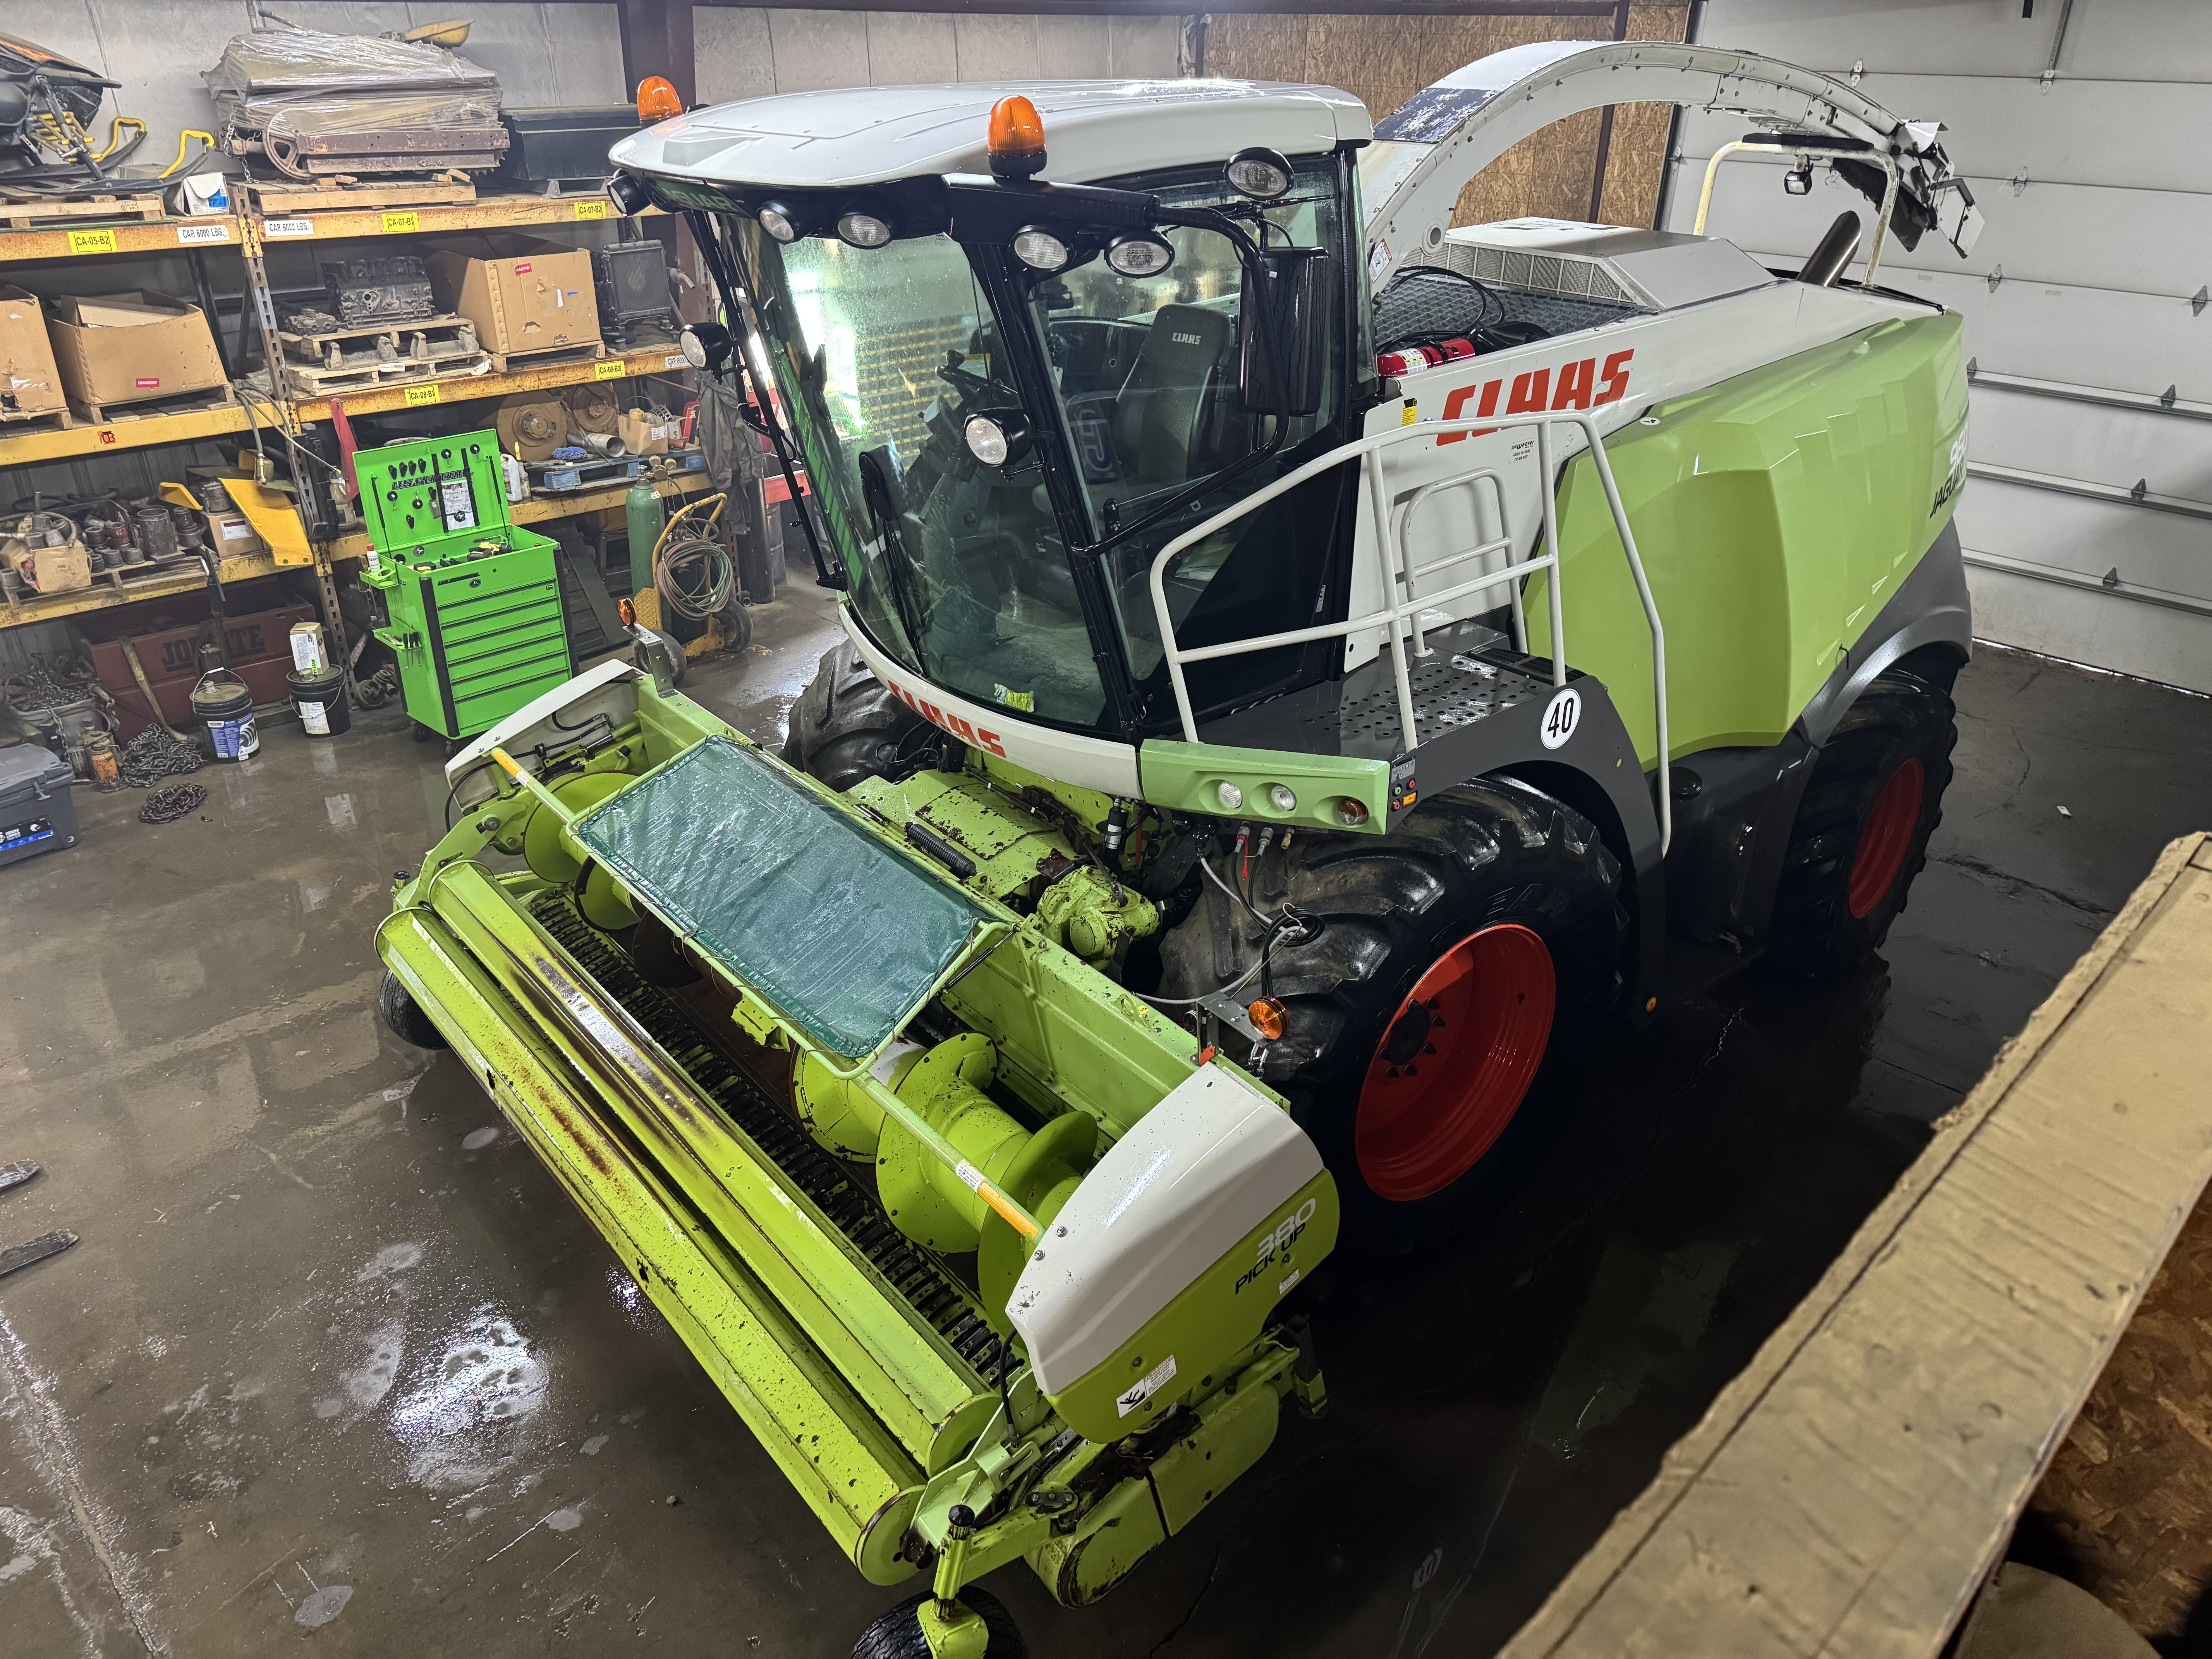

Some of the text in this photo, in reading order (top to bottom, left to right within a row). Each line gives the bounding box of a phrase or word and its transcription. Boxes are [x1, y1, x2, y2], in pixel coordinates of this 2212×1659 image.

[579, 206, 601, 214] CA-07-B2
[270, 223, 281, 232] CAP.
[297, 222, 309, 230] LBS.
[388, 218, 413, 226] CA-07-B1
[76, 236, 109, 246] CA-05-B2
[183, 228, 224, 238] CAP. 6000 LBS.
[1172, 332, 1201, 345] CLAAS
[410, 390, 434, 400] CA-08-B1
[1436, 348, 1635, 446] CLAAS
[1929, 454, 1964, 519] JAGUAR
[888, 679, 1007, 758] CLAAS
[1547, 697, 1575, 739] 40
[1256, 1198, 1316, 1264] 380
[1235, 1247, 1276, 1295] PICK
[1281, 1222, 1306, 1252] UP
[1151, 1354, 1174, 1375] DANGER
